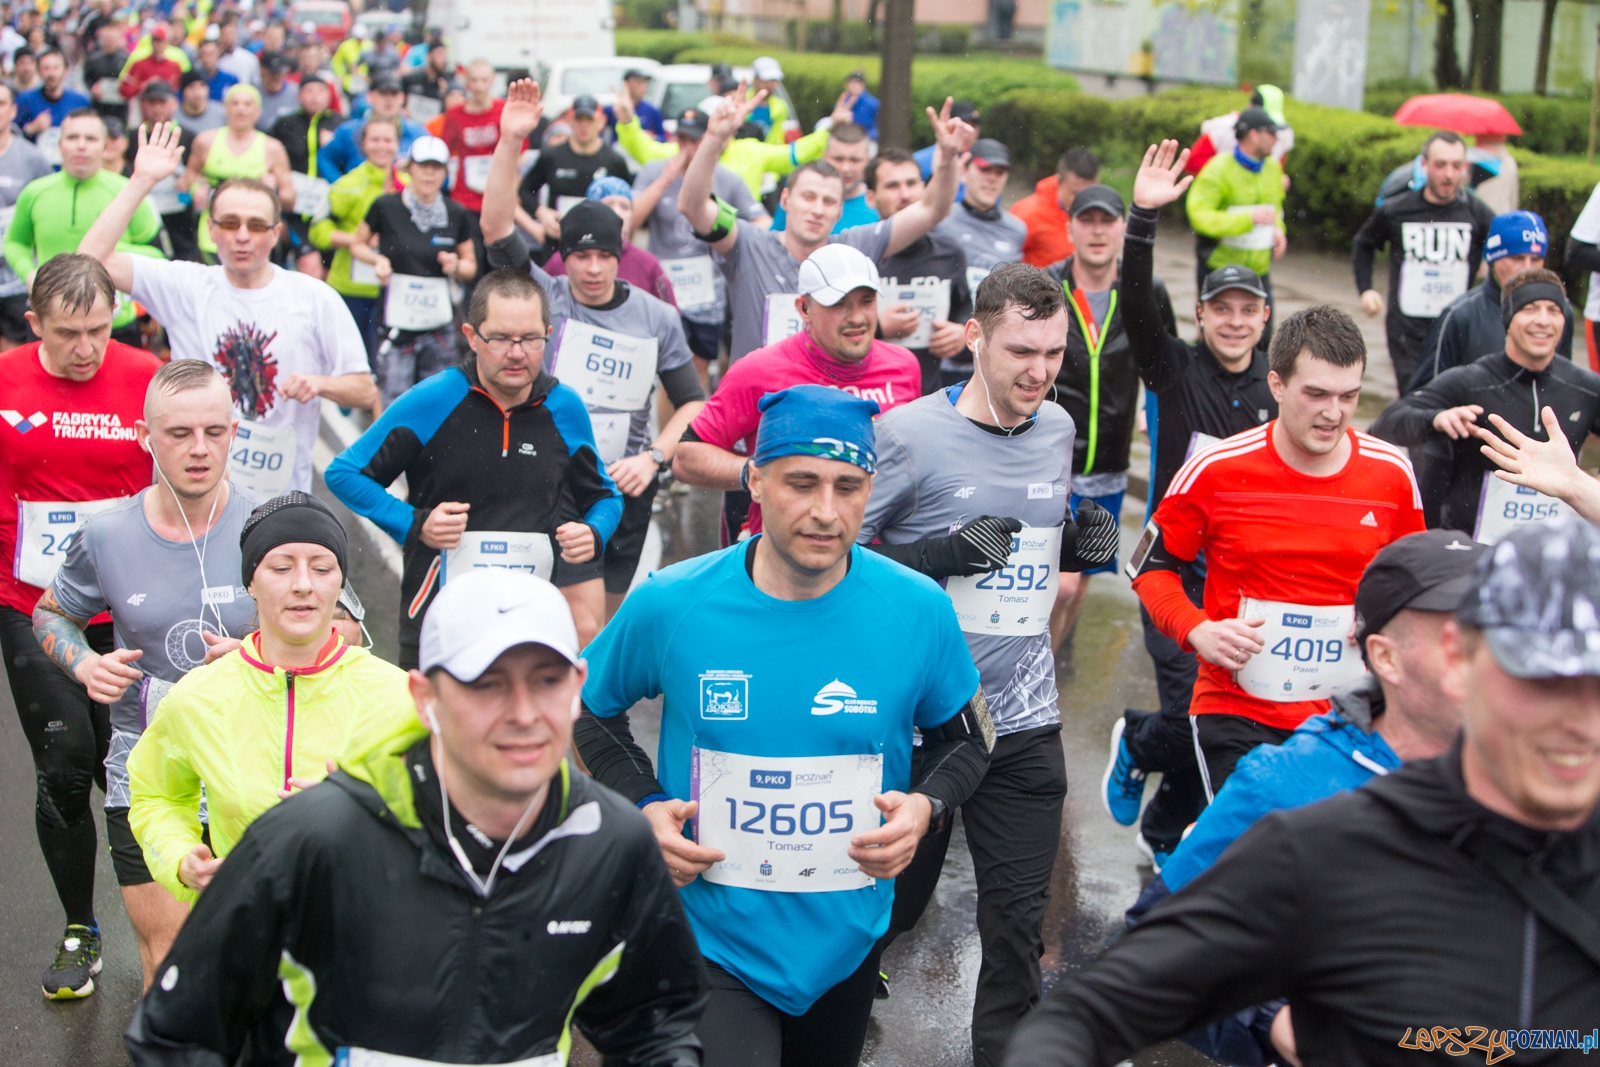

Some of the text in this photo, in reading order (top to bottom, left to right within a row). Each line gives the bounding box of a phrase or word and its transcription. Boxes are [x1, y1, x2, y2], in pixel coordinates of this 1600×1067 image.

[1402, 223, 1472, 262] RUN
[586, 352, 632, 380] 6911
[52, 411, 122, 427] FABRYKA
[53, 424, 138, 441] TRIATHLONU
[232, 448, 283, 471] 490
[954, 486, 976, 499] 4F
[52, 513, 73, 521] 9.PKO
[1503, 500, 1559, 521] 8956
[483, 543, 505, 552] 9.PKO
[975, 564, 1050, 591] 2592
[126, 593, 147, 606] 4F
[998, 594, 1029, 603] Tomasz
[1286, 616, 1309, 625] 9.PKO
[1270, 637, 1343, 663] 4019
[844, 704, 878, 714] SOBÓTKA
[755, 774, 786, 785] 9.PKO
[725, 797, 854, 836] 12605
[767, 841, 813, 851] Tomasz
[799, 868, 817, 877] 4F
